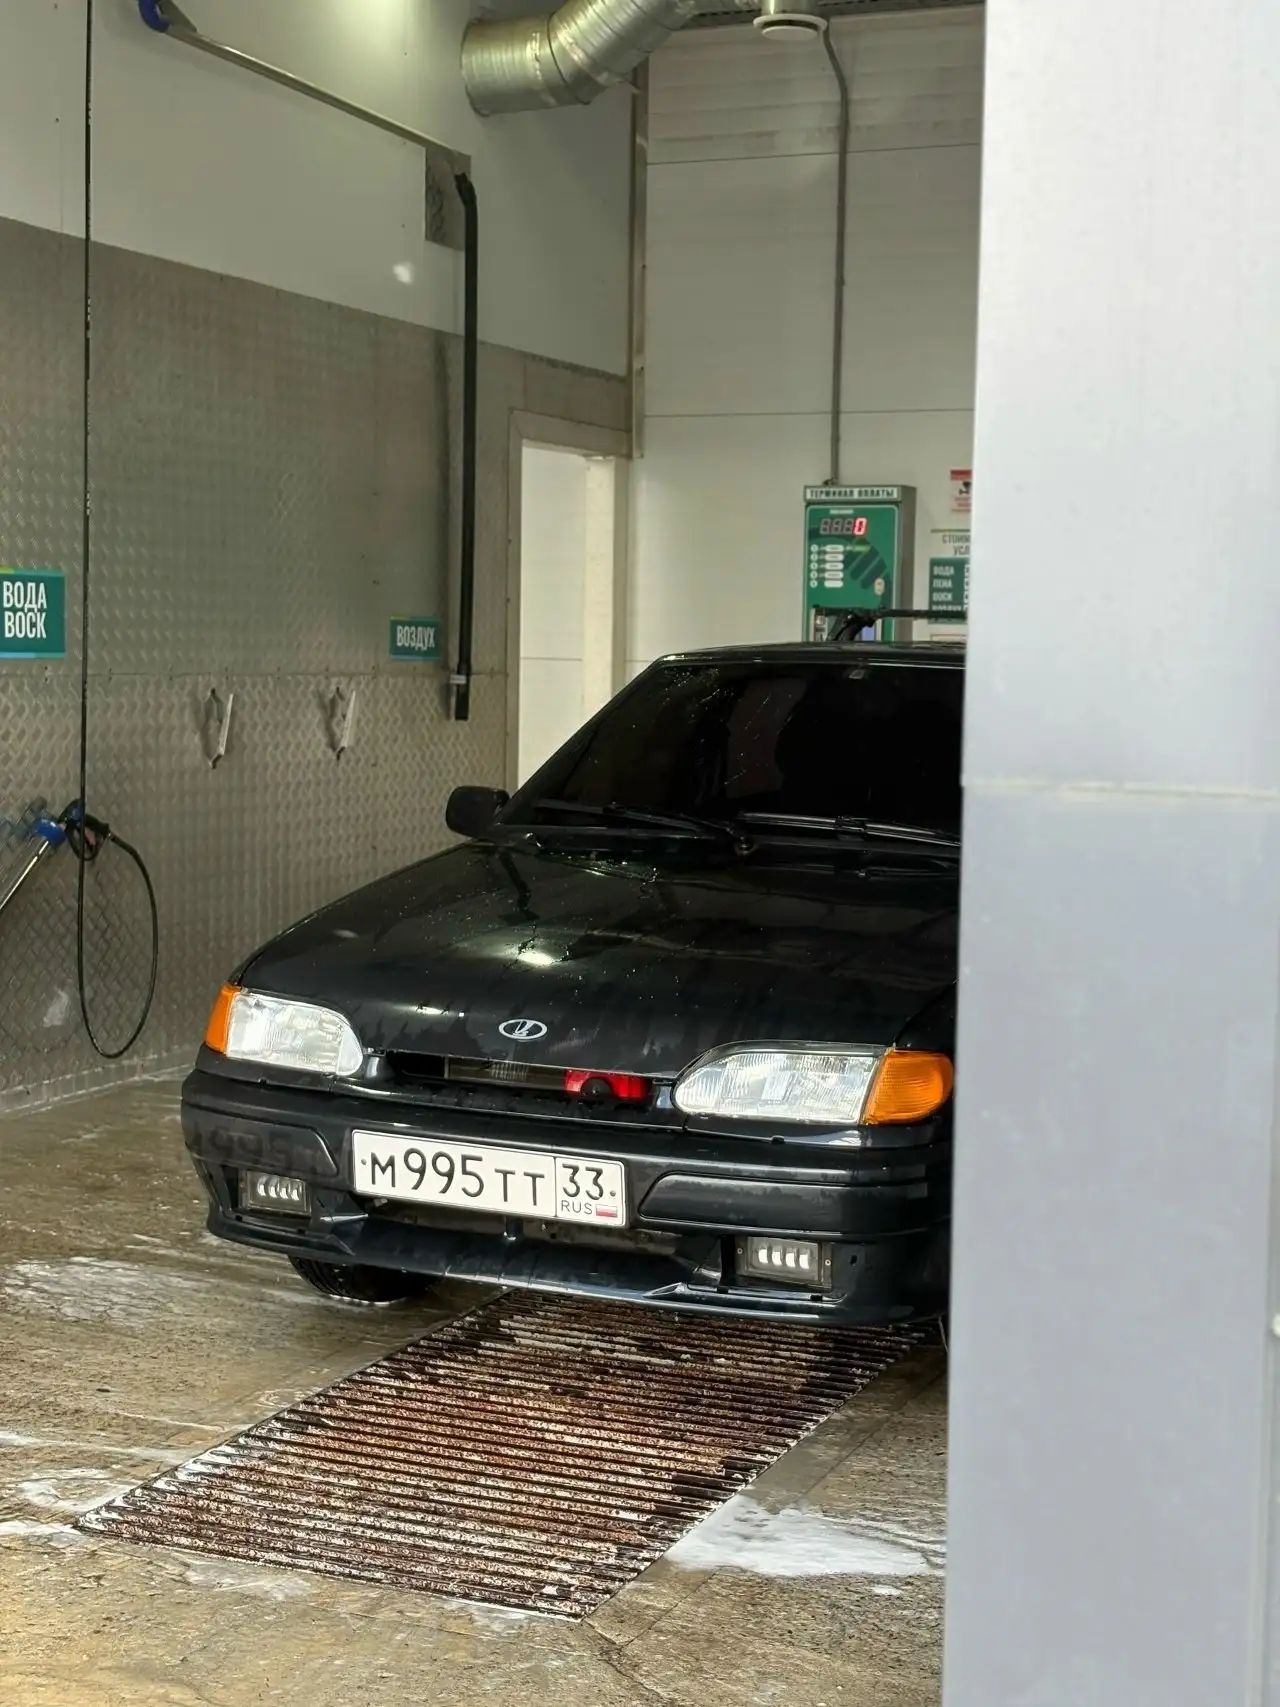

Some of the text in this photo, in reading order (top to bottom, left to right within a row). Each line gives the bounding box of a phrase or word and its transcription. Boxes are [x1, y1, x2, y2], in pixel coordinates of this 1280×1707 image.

[3, 581, 47, 613] ВОДА
[4, 611, 47, 638] ВОСК
[396, 625, 435, 651] ВОЗДУХ
[370, 1147, 605, 1207] М995ТТ 33
[561, 1202, 594, 1216] RUS
